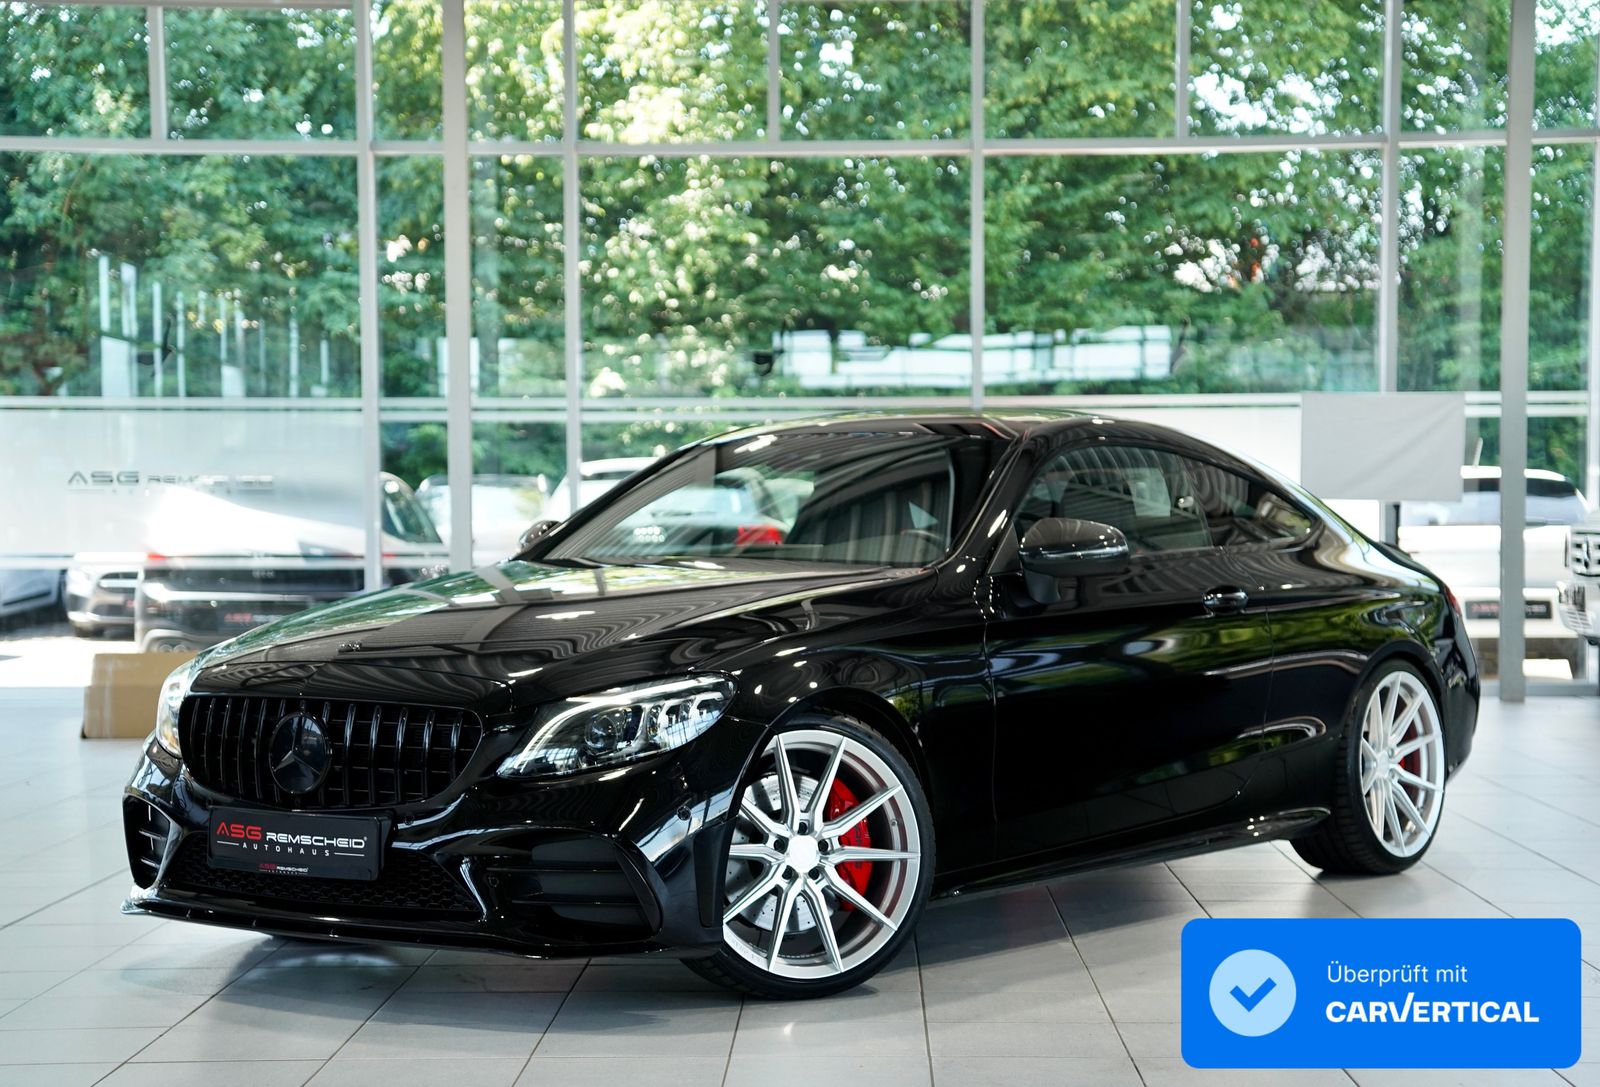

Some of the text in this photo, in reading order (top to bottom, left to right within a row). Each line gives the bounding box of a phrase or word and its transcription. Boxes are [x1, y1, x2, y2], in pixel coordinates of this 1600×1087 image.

[68, 471, 139, 485] ASG
[217, 821, 365, 849] ASG REMSCHEID
[242, 842, 330, 857] AUTOHAUS
